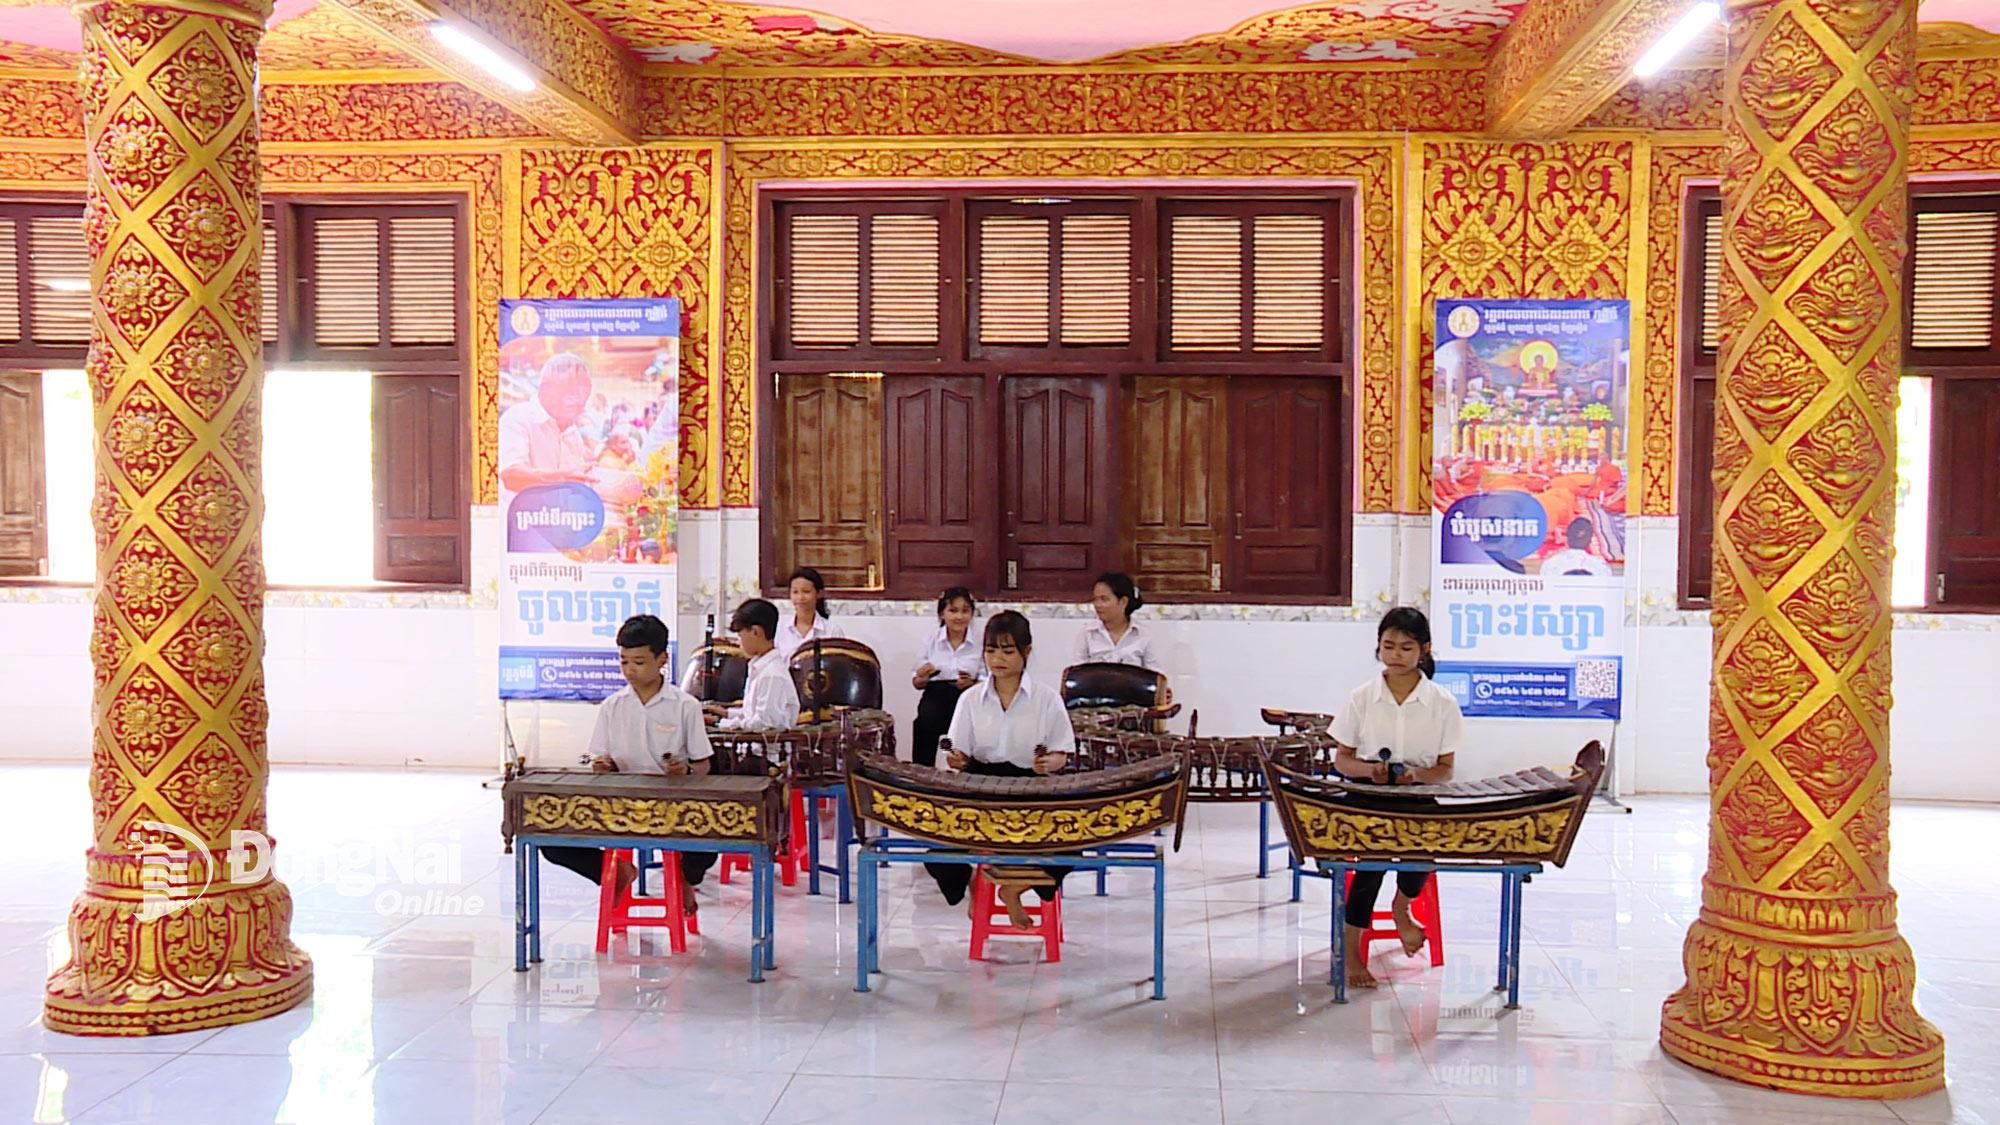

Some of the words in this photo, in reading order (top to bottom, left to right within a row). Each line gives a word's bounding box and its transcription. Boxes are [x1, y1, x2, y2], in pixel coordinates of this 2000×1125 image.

[1450, 511, 1539, 542] បំបួសនាគ
[1448, 602, 1605, 651] ព្រះវស្សា
